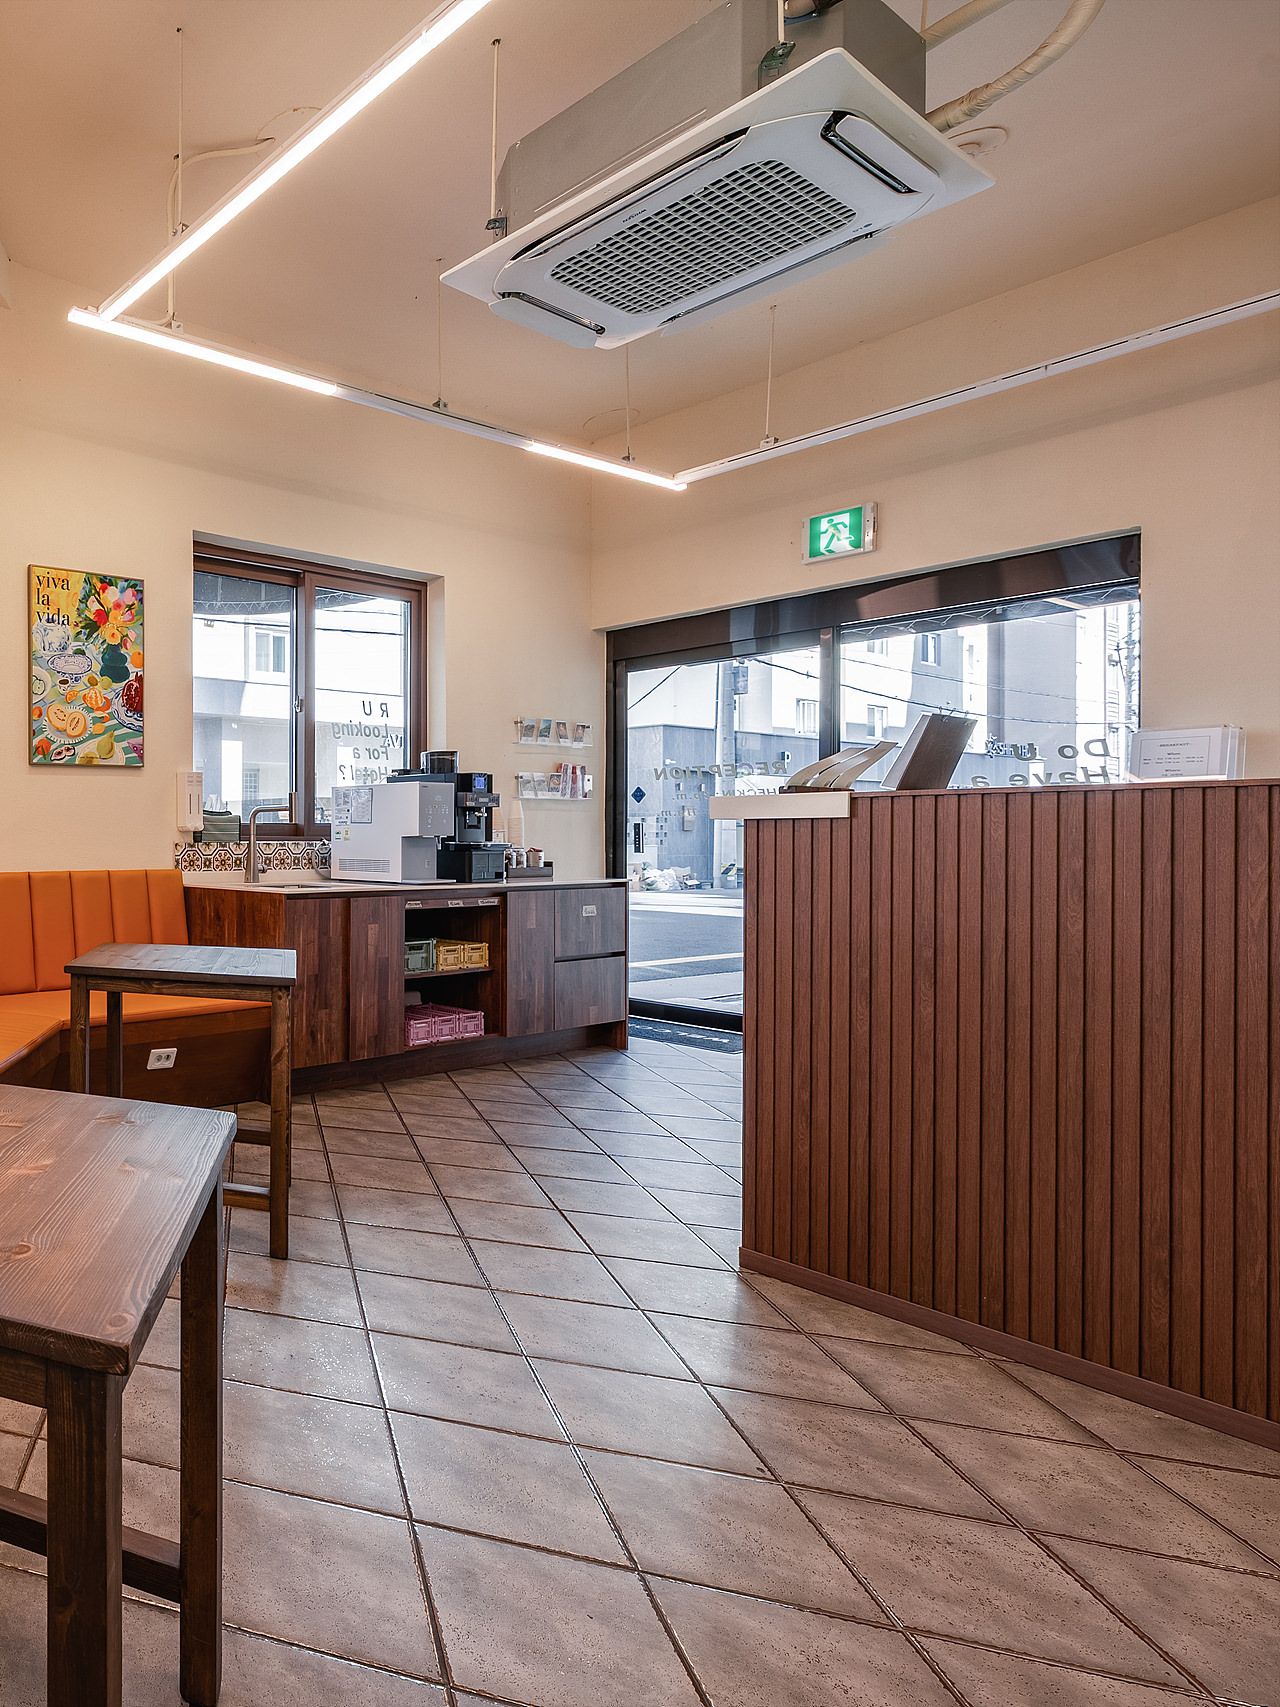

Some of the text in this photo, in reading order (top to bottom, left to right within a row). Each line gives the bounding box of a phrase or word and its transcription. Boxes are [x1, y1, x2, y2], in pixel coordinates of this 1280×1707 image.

[36, 571, 70, 591] viva
[37, 588, 50, 606] la
[36, 607, 70, 626] vida
